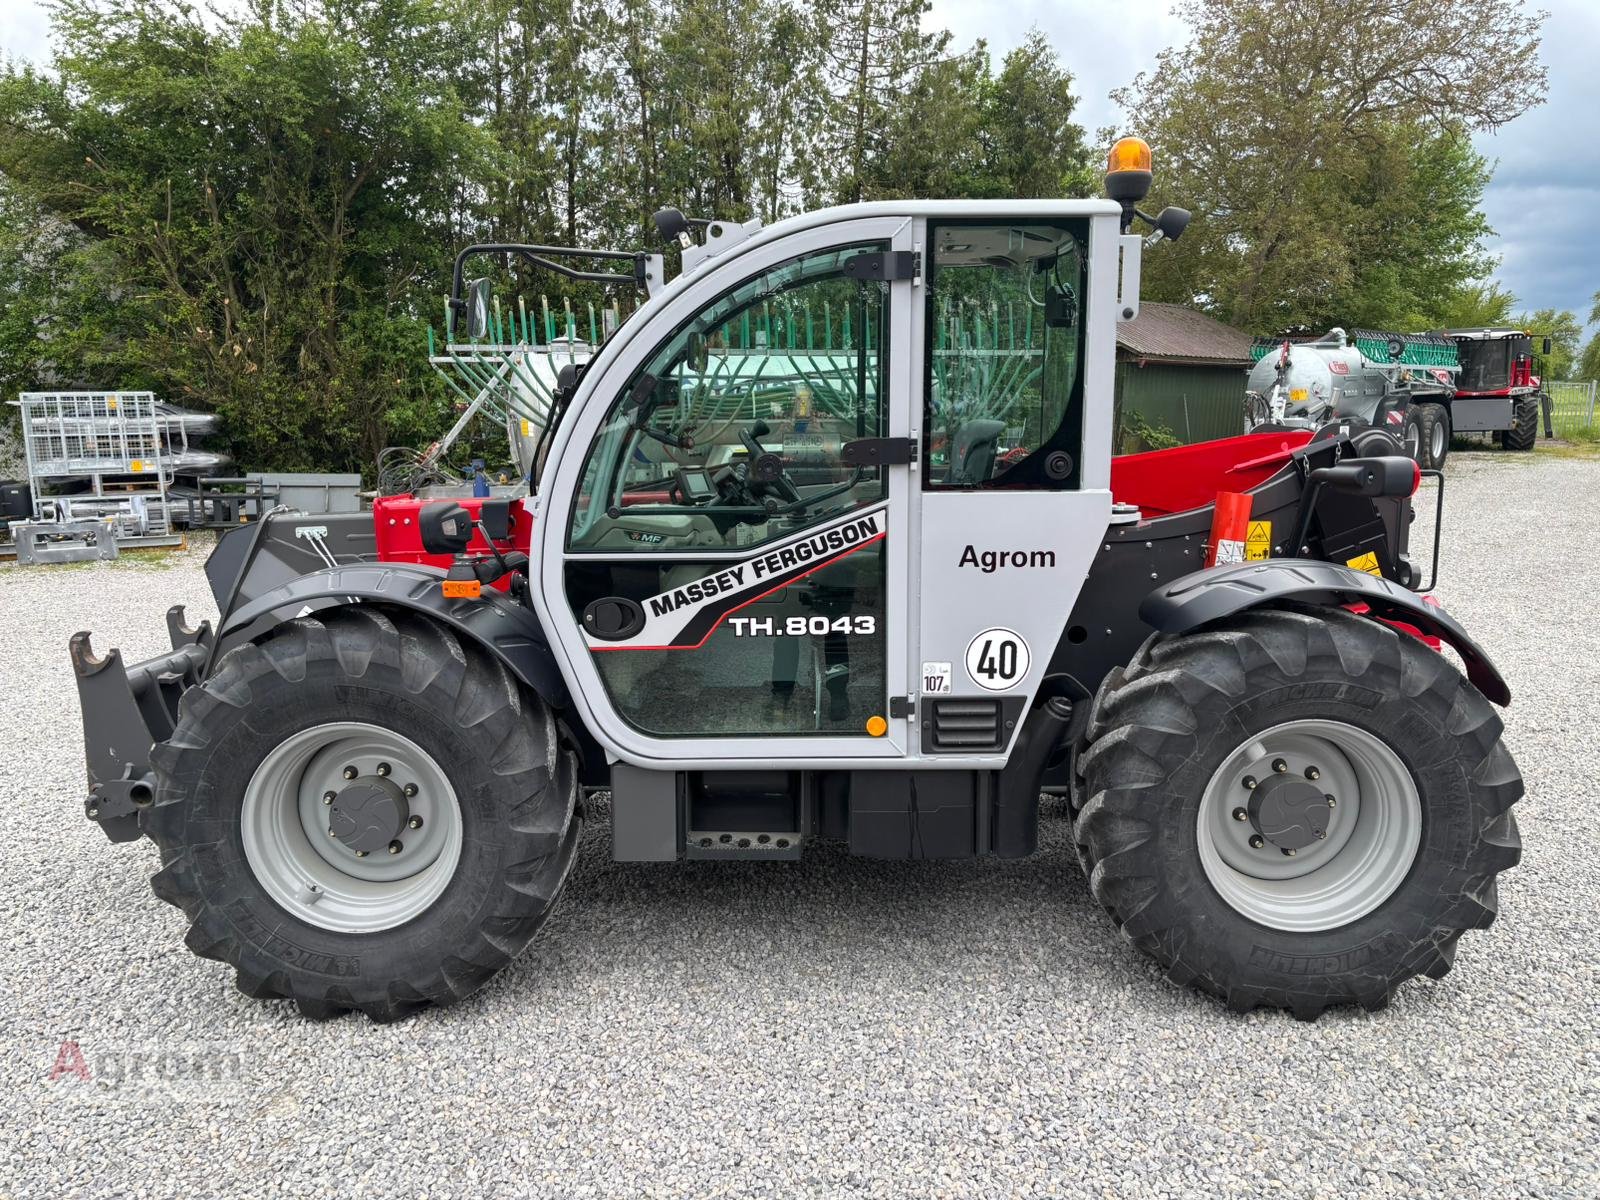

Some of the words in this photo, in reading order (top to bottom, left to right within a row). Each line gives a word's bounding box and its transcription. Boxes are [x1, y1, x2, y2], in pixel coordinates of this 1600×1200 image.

[641, 534, 662, 543] MF
[649, 565, 746, 618] MASSEY
[751, 516, 879, 580] FERGUSON
[958, 544, 1056, 574] Agrom
[728, 615, 876, 637] TH.8043
[976, 639, 1018, 680] 40
[924, 675, 944, 691] 107
